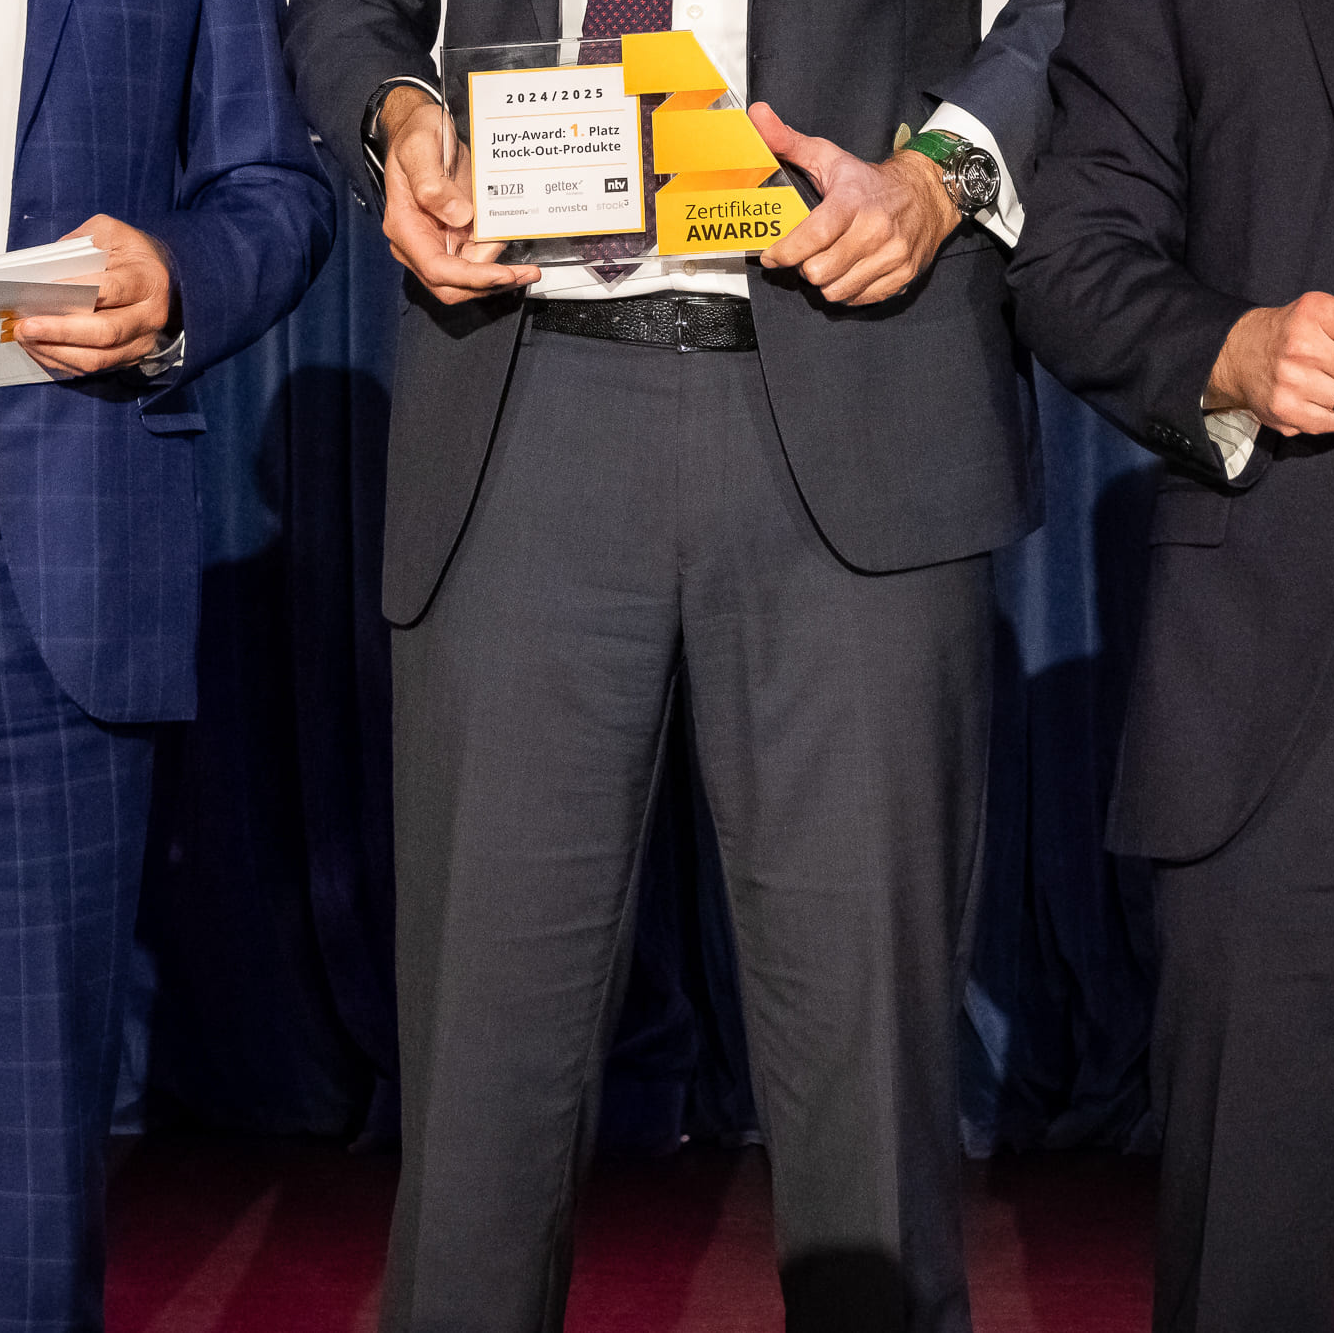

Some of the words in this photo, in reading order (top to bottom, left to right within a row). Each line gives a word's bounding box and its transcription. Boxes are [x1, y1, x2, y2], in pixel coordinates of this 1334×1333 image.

[491, 127, 567, 146] Jury-Award:
[570, 123, 585, 138] 1.
[588, 125, 620, 138] Platz
[491, 141, 622, 159] Knock-Out-Produkte
[500, 183, 525, 196] DZB
[545, 180, 579, 195] gettex
[606, 180, 627, 191] ntv
[548, 203, 588, 214] onvista
[685, 200, 782, 220] Zertifikate
[686, 220, 782, 243] AWARDS
